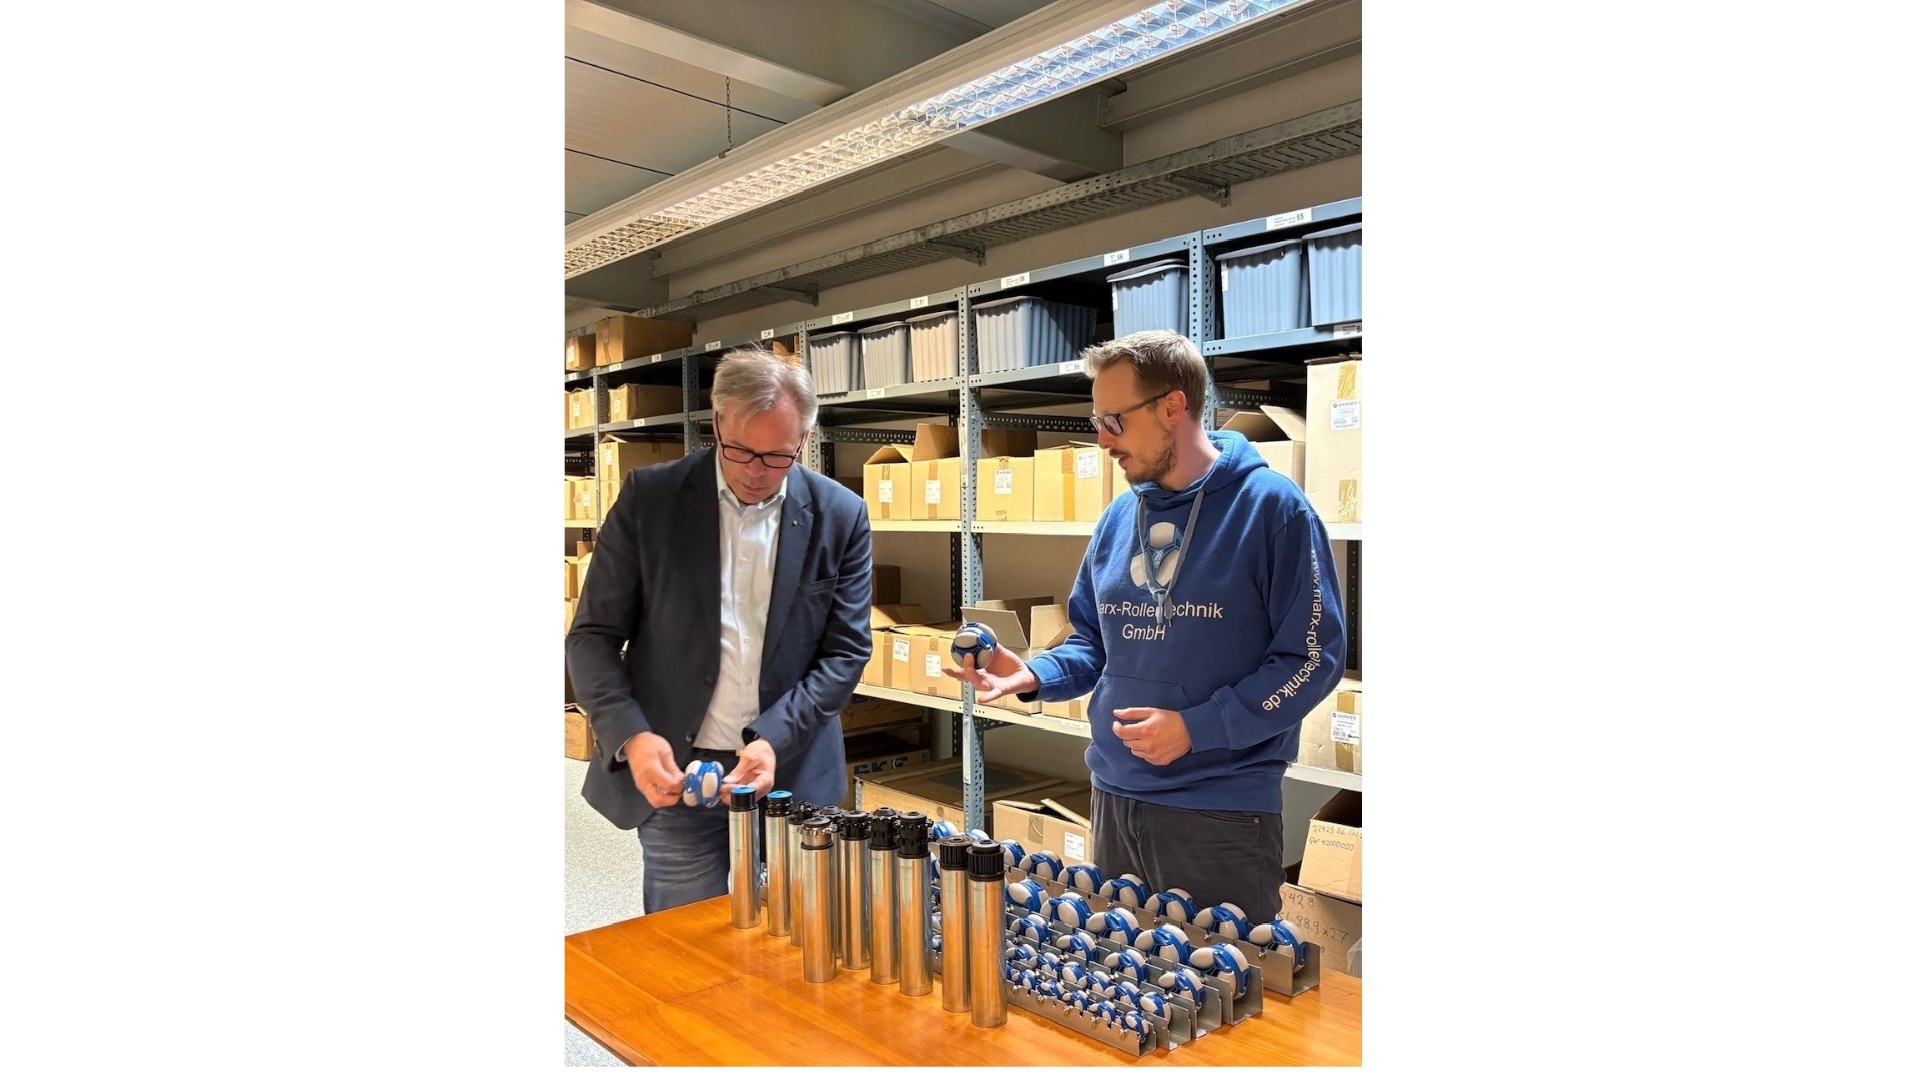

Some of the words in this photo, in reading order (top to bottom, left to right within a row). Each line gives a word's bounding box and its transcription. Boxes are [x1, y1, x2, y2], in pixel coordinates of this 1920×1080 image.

[1296, 212, 1305, 221] 55
[1098, 601, 1223, 619] arx-Rolleechnik
[1122, 623, 1166, 640] GmbH
